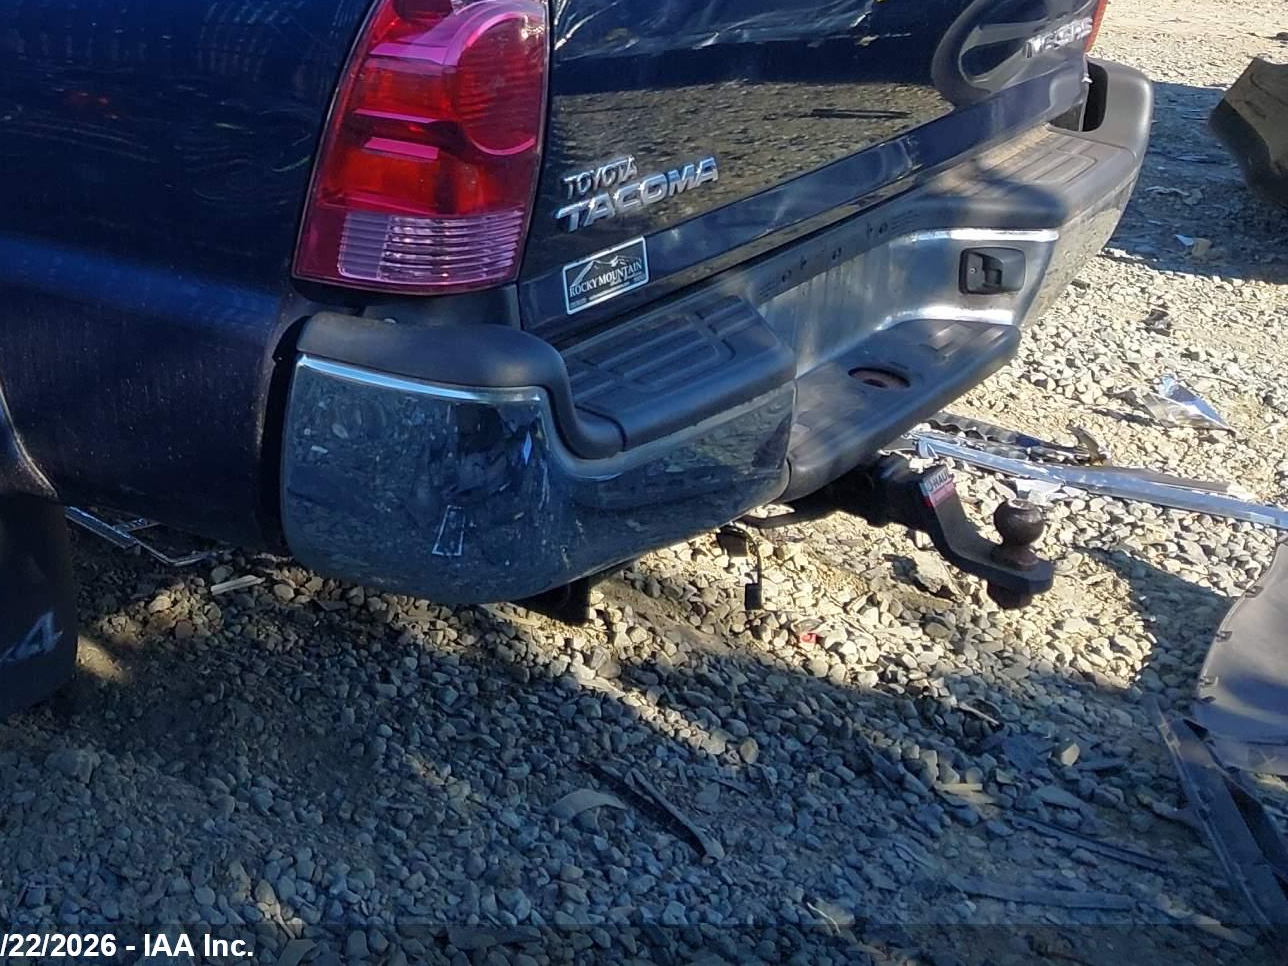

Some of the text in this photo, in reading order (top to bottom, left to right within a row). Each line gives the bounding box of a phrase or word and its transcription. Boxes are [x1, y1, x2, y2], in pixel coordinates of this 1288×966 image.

[554, 156, 719, 233] TACOMA
[563, 154, 637, 200] TOYOTA
[569, 278, 598, 298] ROCKY
[597, 259, 643, 287] MOUNTAIN
